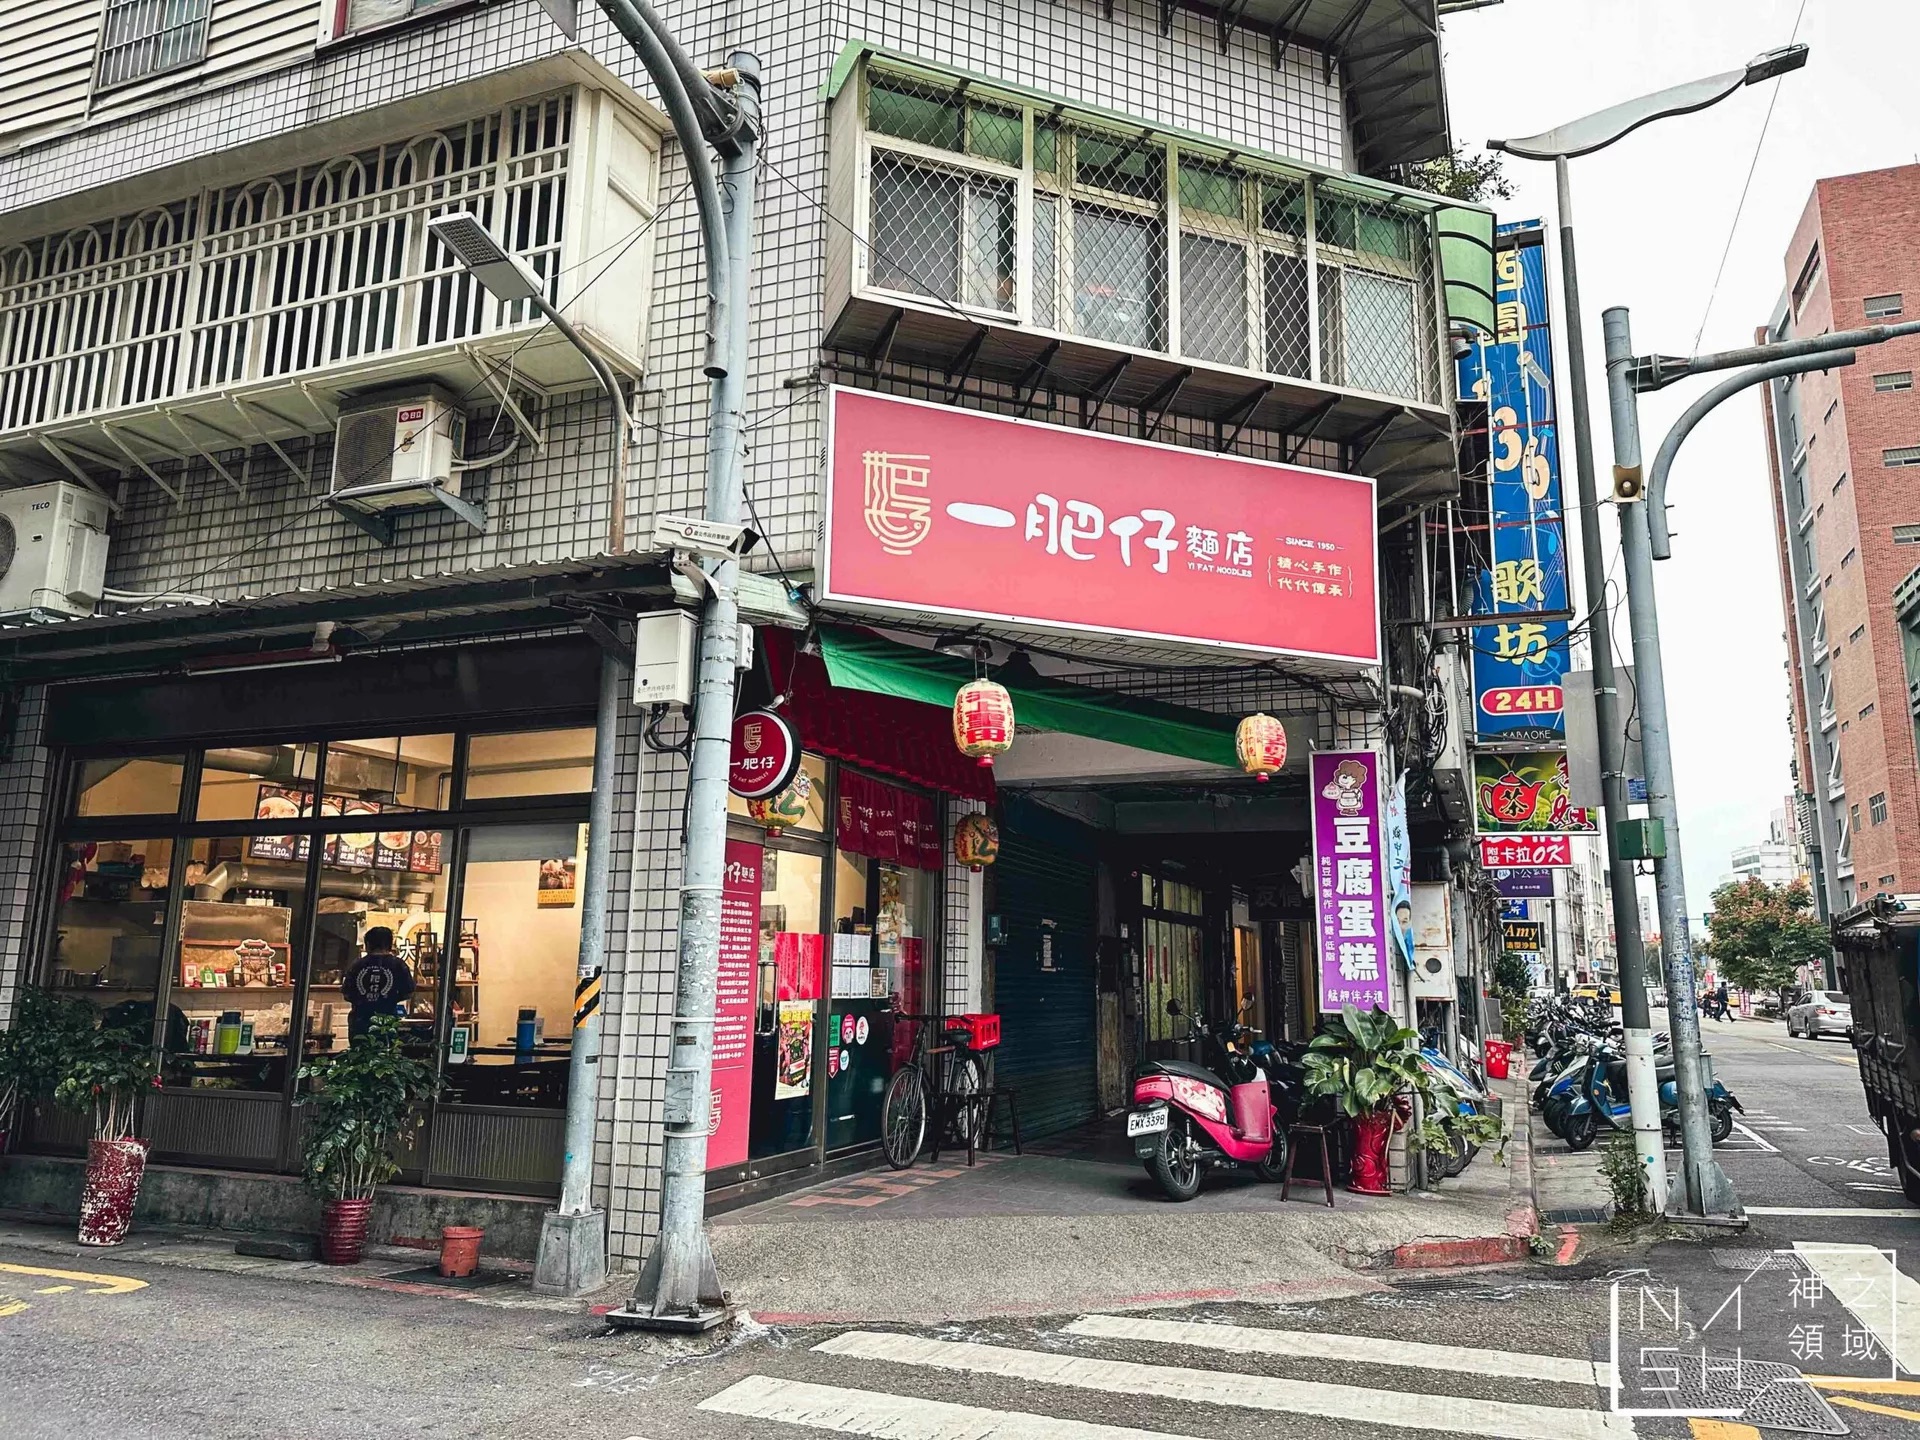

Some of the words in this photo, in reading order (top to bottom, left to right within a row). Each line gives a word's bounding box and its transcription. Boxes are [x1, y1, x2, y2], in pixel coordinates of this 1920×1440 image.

[31, 501, 50, 511] TECO
[946, 493, 1179, 574] 一肥仔
[1185, 525, 1254, 566] 麵店
[1285, 536, 1315, 549] SINCE
[1317, 541, 1336, 552] 1950
[1187, 561, 1195, 570] YI
[1197, 563, 1214, 573] FAT
[1216, 566, 1253, 578] NOODLES
[1276, 576, 1343, 598] 代代傳承
[1495, 690, 1556, 712] 24H
[1502, 729, 1551, 741] KARAOKE
[729, 756, 776, 770] 一肥仔
[1500, 787, 1529, 817] 茶
[1500, 844, 1565, 864] 卡拉OK
[1320, 856, 1333, 909] 純豆漿製作
[1333, 816, 1380, 982] 豆腐蛋糕
[1504, 923, 1538, 941] Amy
